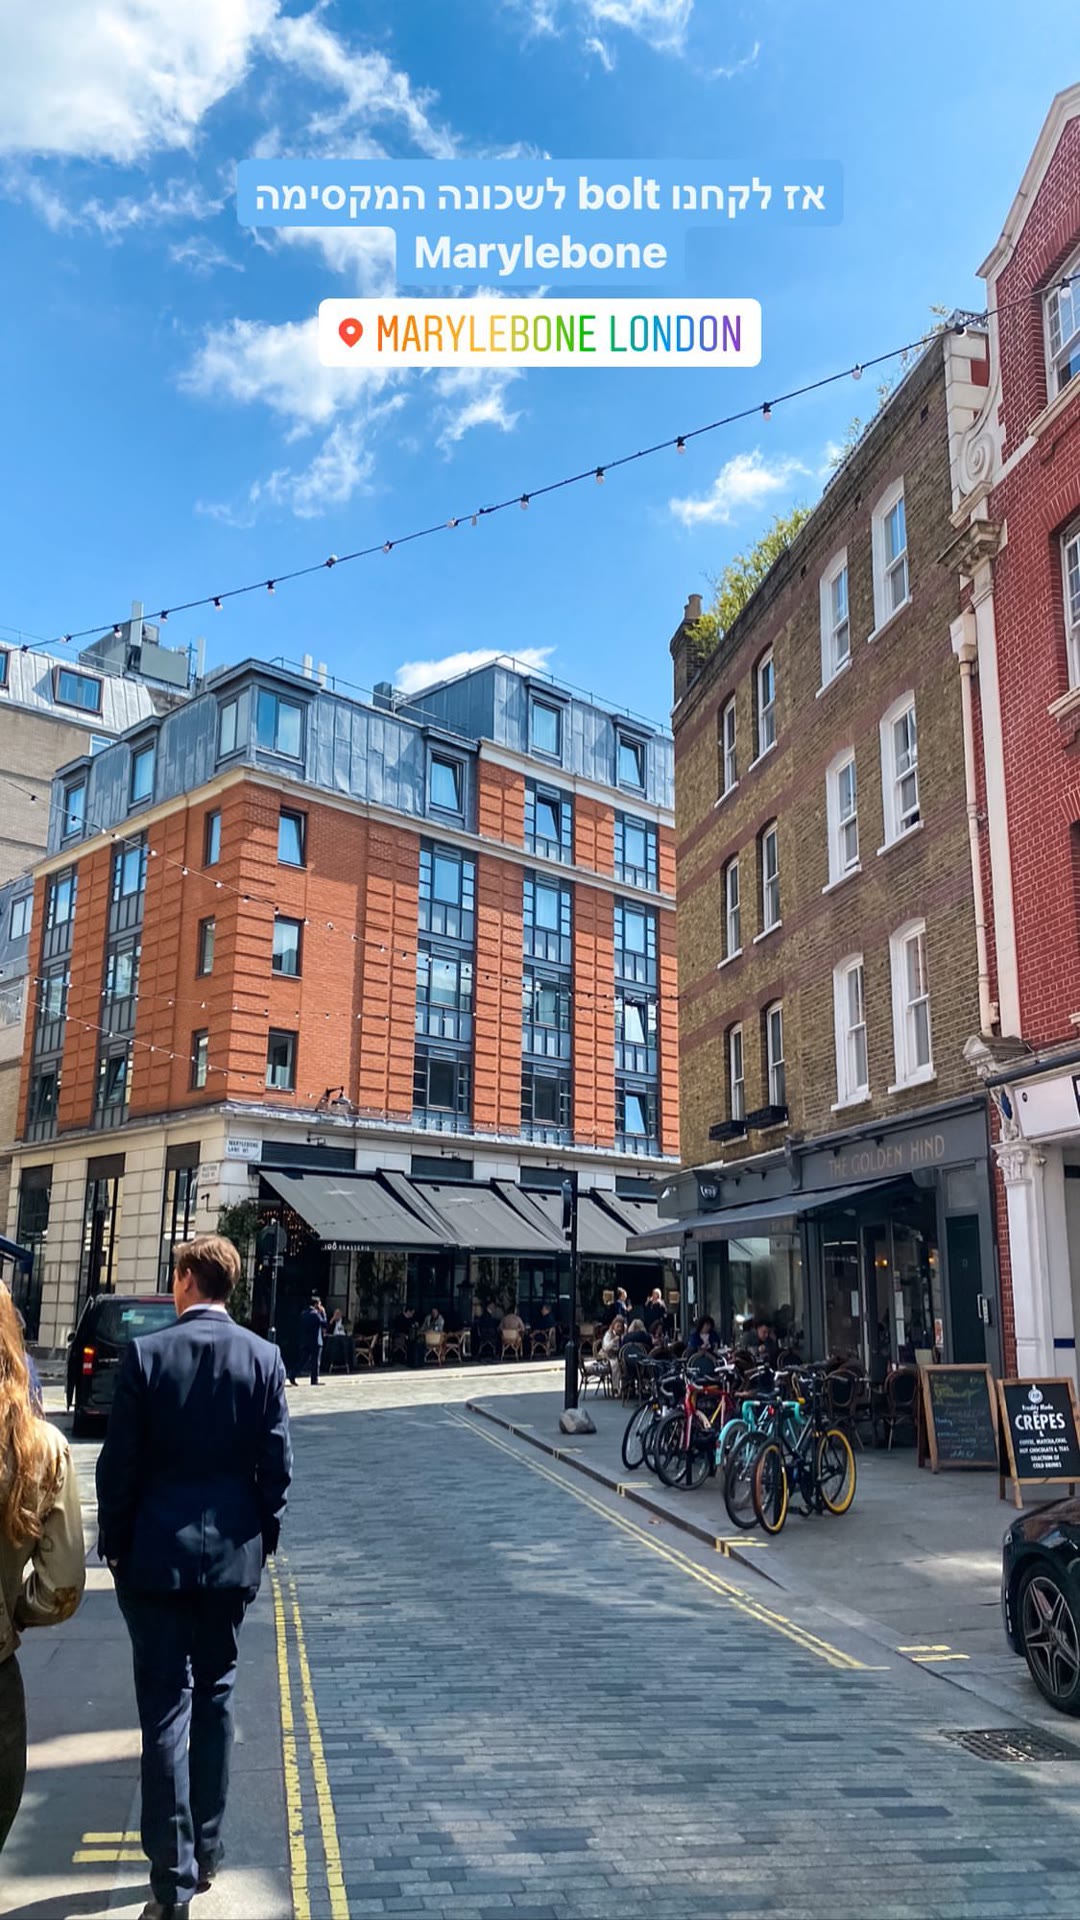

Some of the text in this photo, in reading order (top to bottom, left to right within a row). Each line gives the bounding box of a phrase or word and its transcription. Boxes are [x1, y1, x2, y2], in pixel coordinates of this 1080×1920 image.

[828, 1134, 945, 1177] THE GOLDEN HIND
